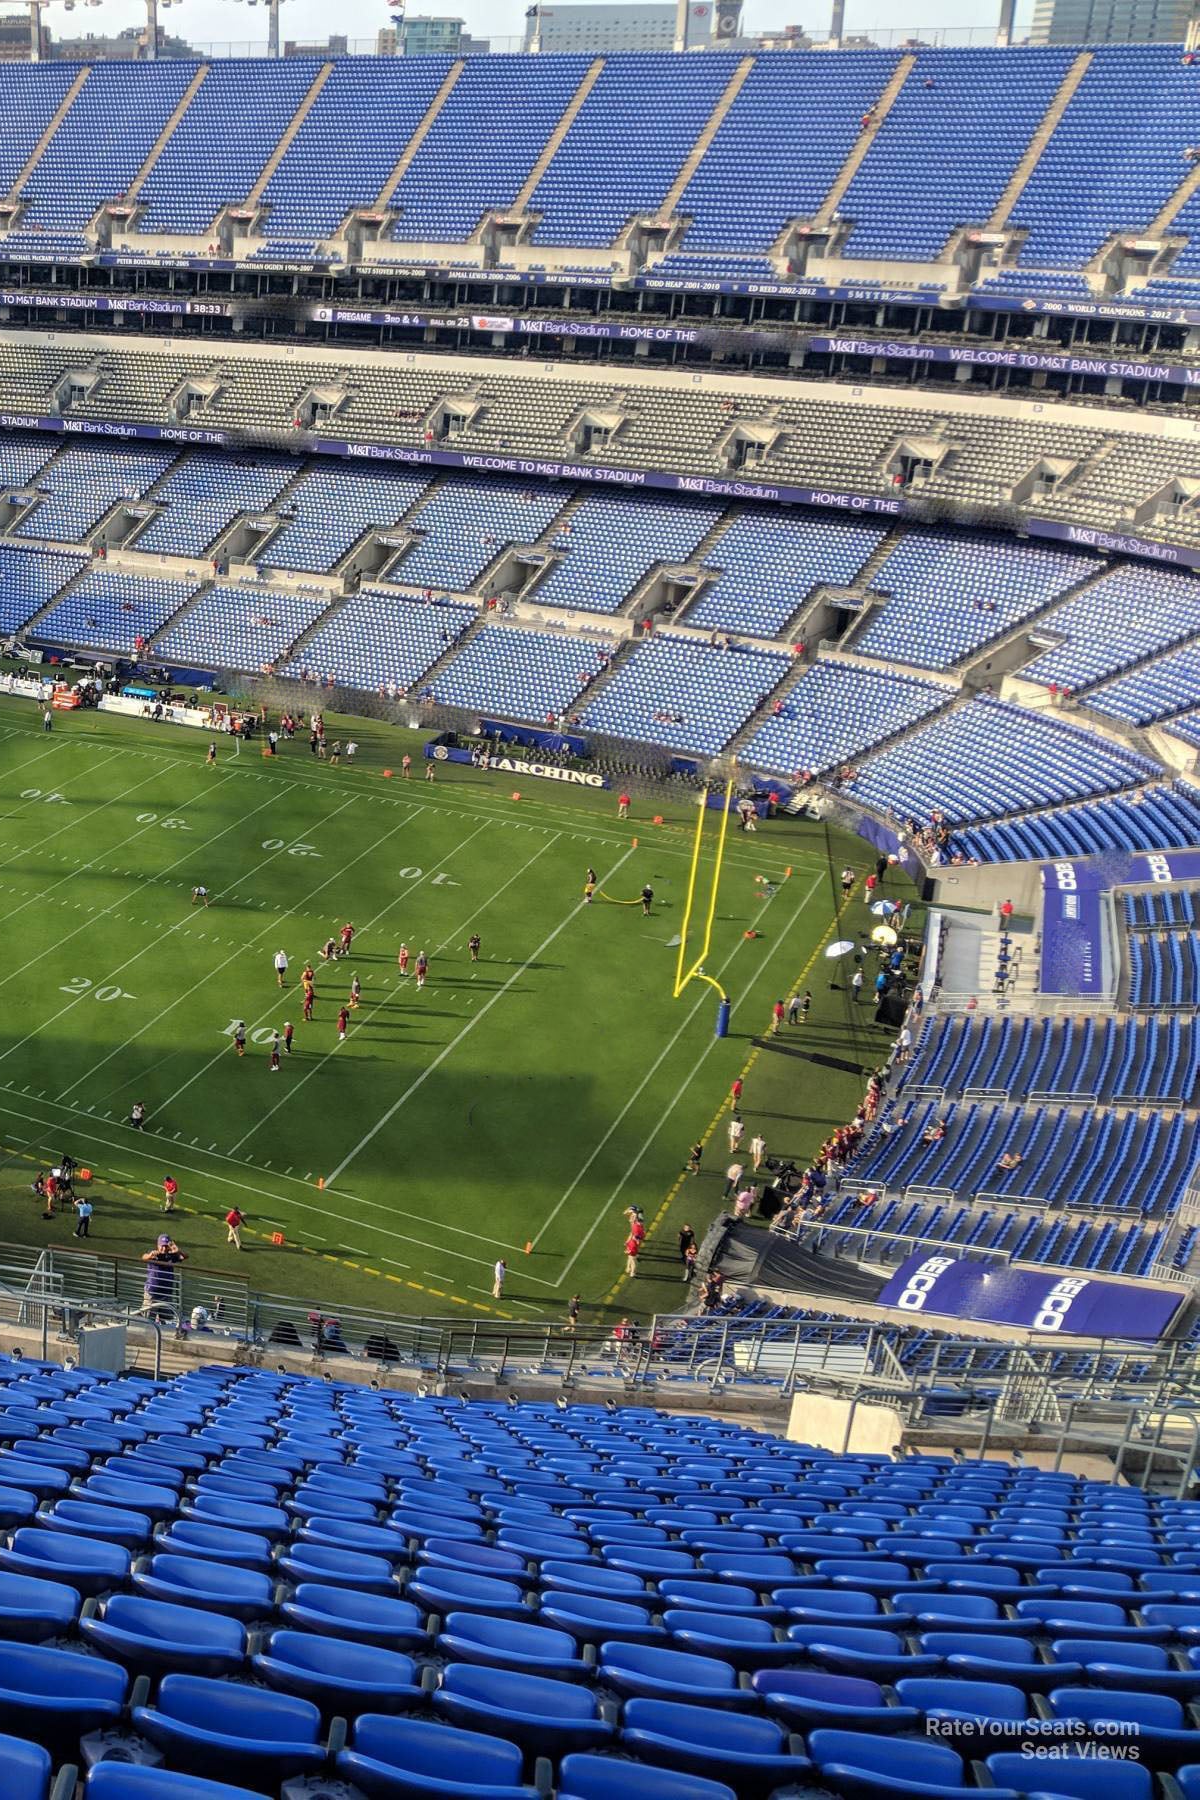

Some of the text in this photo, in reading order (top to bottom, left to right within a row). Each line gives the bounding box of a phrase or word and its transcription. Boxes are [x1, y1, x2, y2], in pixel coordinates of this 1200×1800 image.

[469, 272, 487, 280] LEWIS
[558, 276, 576, 284] LEWIS
[645, 280, 664, 288] TODD
[665, 281, 683, 289] HEAP
[748, 285, 759, 293] ED
[3, 295, 15, 304] TO
[16, 296, 34, 305] M&T
[36, 296, 59, 306] BANK
[60, 298, 97, 308] STADIUM
[193, 304, 220, 313] 38:33
[337, 311, 371, 322] PREGAME
[1043, 302, 1171, 319] 2000 WORLD CHAMPIONS 2012
[384, 315, 419, 324] 3RD & 4
[457, 318, 469, 327] 25
[620, 326, 654, 339] HOME
[656, 328, 672, 340] OF
[950, 349, 1017, 365] WELCOME
[1019, 352, 1039, 366] TO
[1039, 354, 1069, 369] M&T
[1071, 357, 1107, 373] BANK
[1110, 361, 1170, 380] STADIUM
[2, 415, 39, 427] STADIUM
[160, 430, 223, 443] HOME OF THE
[463, 455, 645, 483] WELCOME TO M&T BANK STADIUM
[811, 492, 899, 513] HOME OF THE
[480, 753, 606, 788] MARCHING
[135, 812, 186, 830] 30
[261, 839, 316, 856] 20
[399, 866, 451, 885] 10
[59, 976, 123, 1001] 20
[897, 1256, 956, 1311] GEICO
[1034, 1277, 1091, 1331] GEICO
